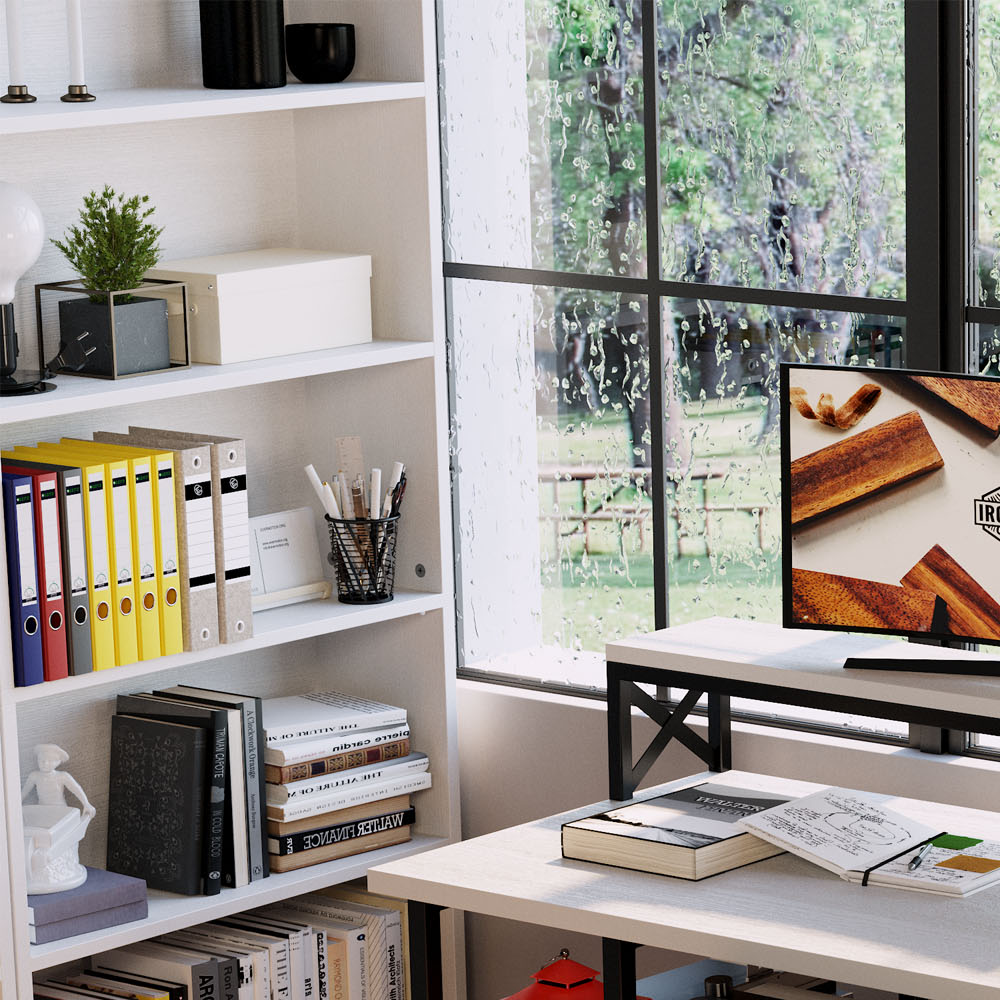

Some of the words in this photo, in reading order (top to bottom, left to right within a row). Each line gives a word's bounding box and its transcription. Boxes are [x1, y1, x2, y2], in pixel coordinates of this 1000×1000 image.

[247, 716, 257, 754] Clockwork
[248, 753, 257, 780] Orange
[224, 966, 233, 991] Ron
[276, 943, 289, 982] THE
[333, 957, 343, 991] RAYMOND
[387, 944, 396, 986] Architects
[304, 978, 312, 997] arts
